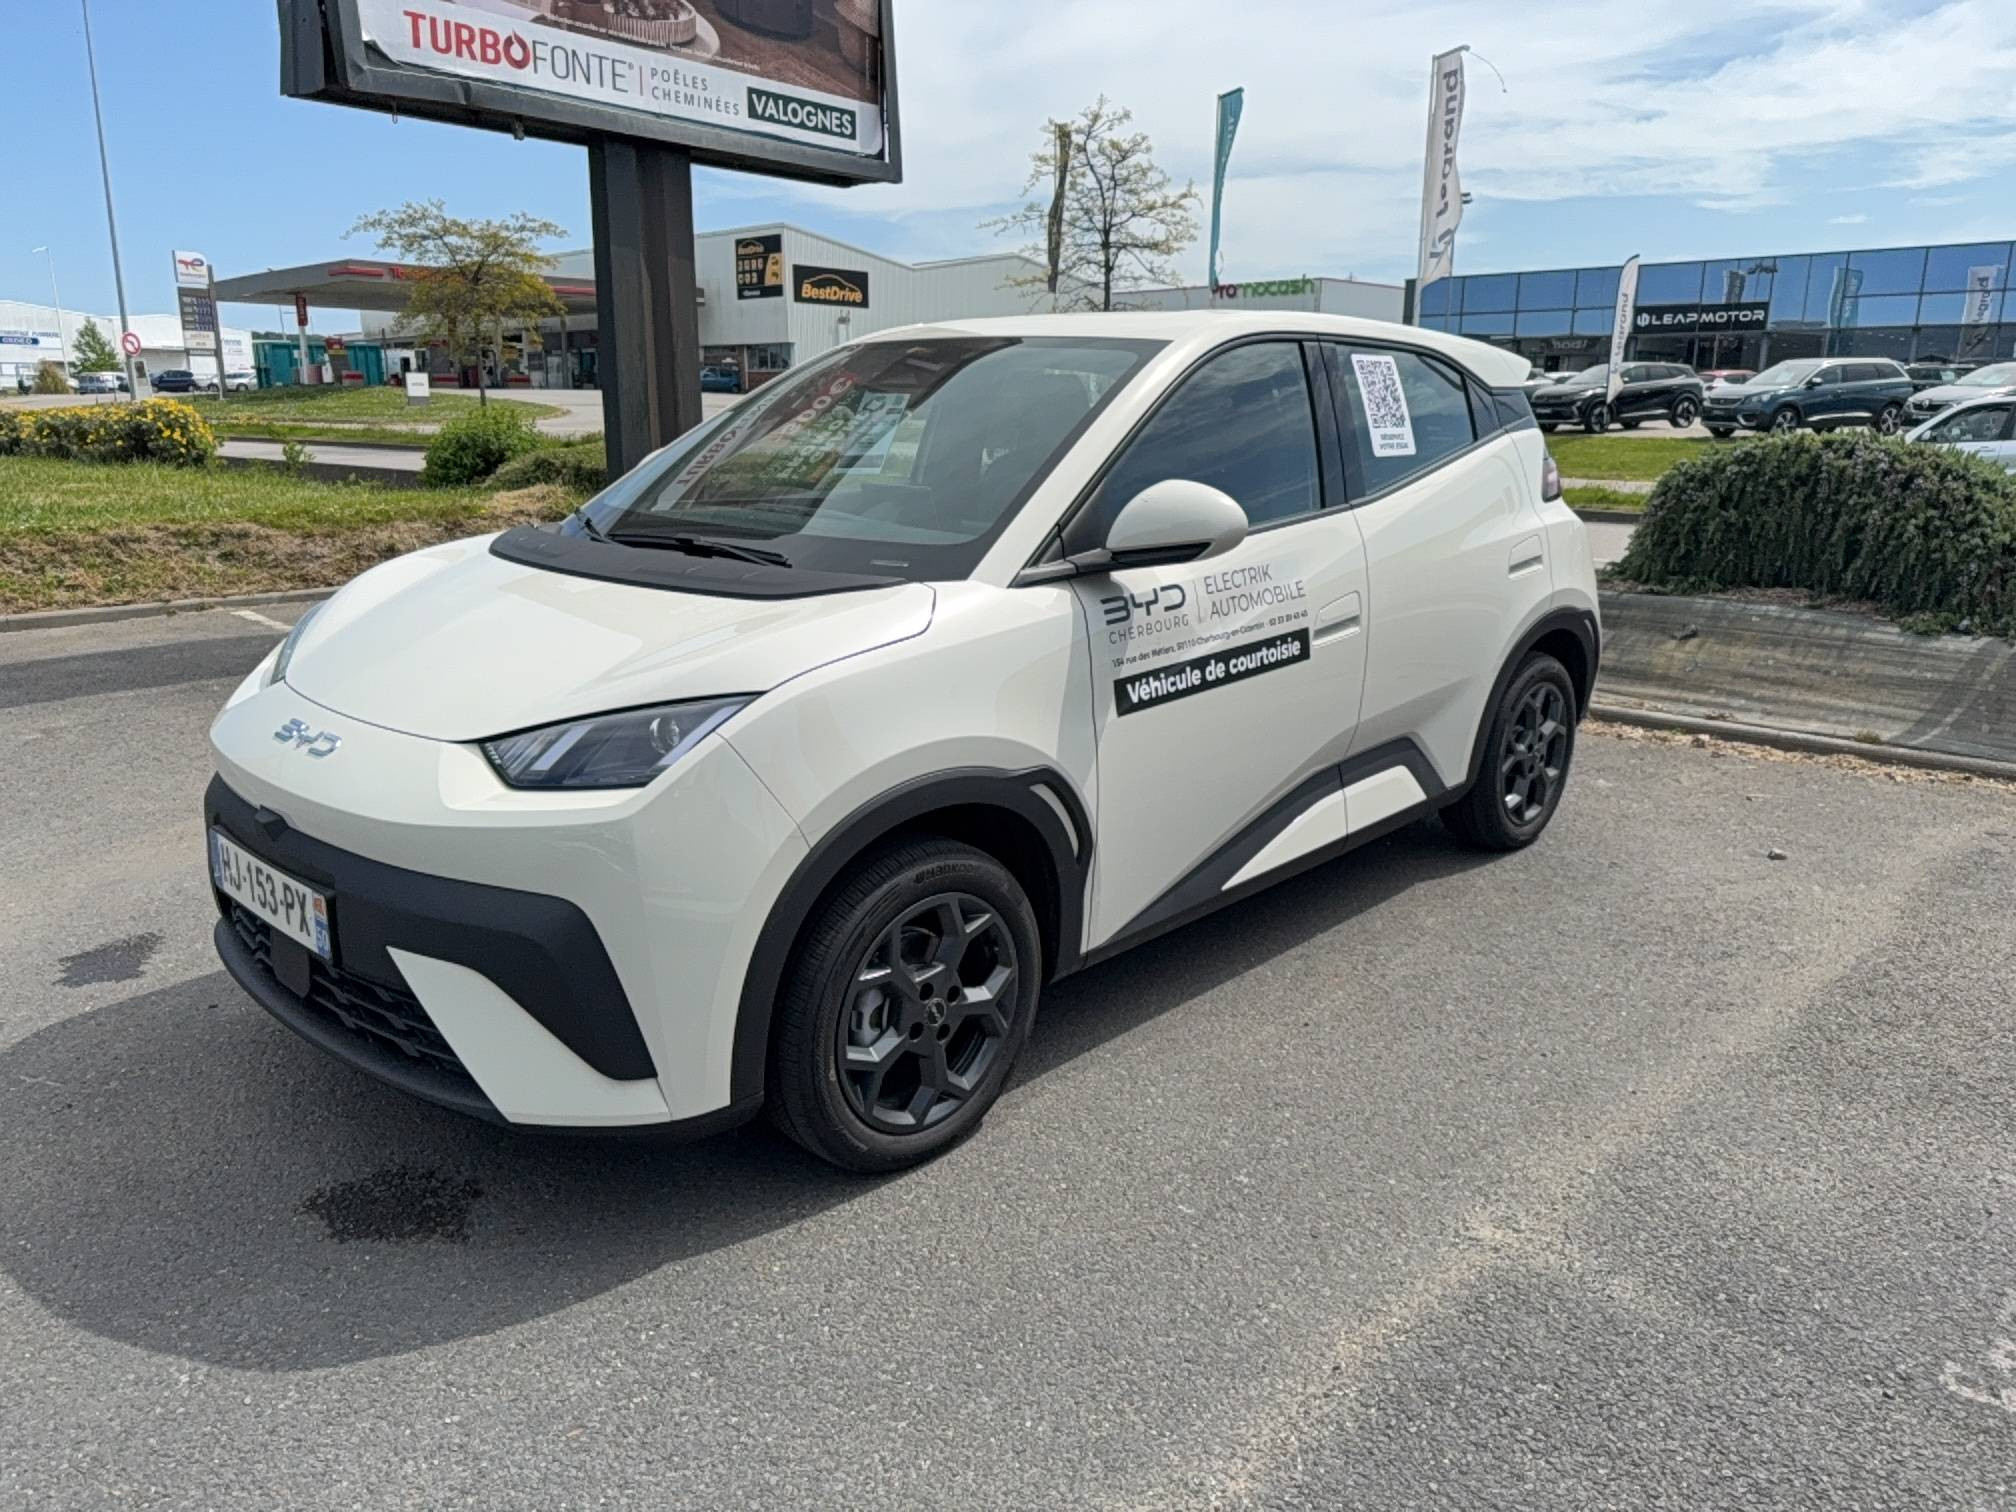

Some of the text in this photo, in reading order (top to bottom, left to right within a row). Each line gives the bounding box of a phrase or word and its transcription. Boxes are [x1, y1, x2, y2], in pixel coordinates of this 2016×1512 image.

[650, 66, 708, 92] POÊLES
[651, 86, 740, 117] CHEMINÉES
[751, 93, 853, 136] VALOGNES
[801, 283, 863, 303] BestDrive
[1651, 309, 1765, 326] LEAPMOTOR
[1204, 563, 1273, 595] ELECTRIK
[1101, 583, 1187, 626] BYD
[1209, 579, 1307, 621] AUTOMOBILE
[1108, 613, 1190, 645] CHERBOURG
[1126, 637, 1302, 705] Véhicule de courtoisie
